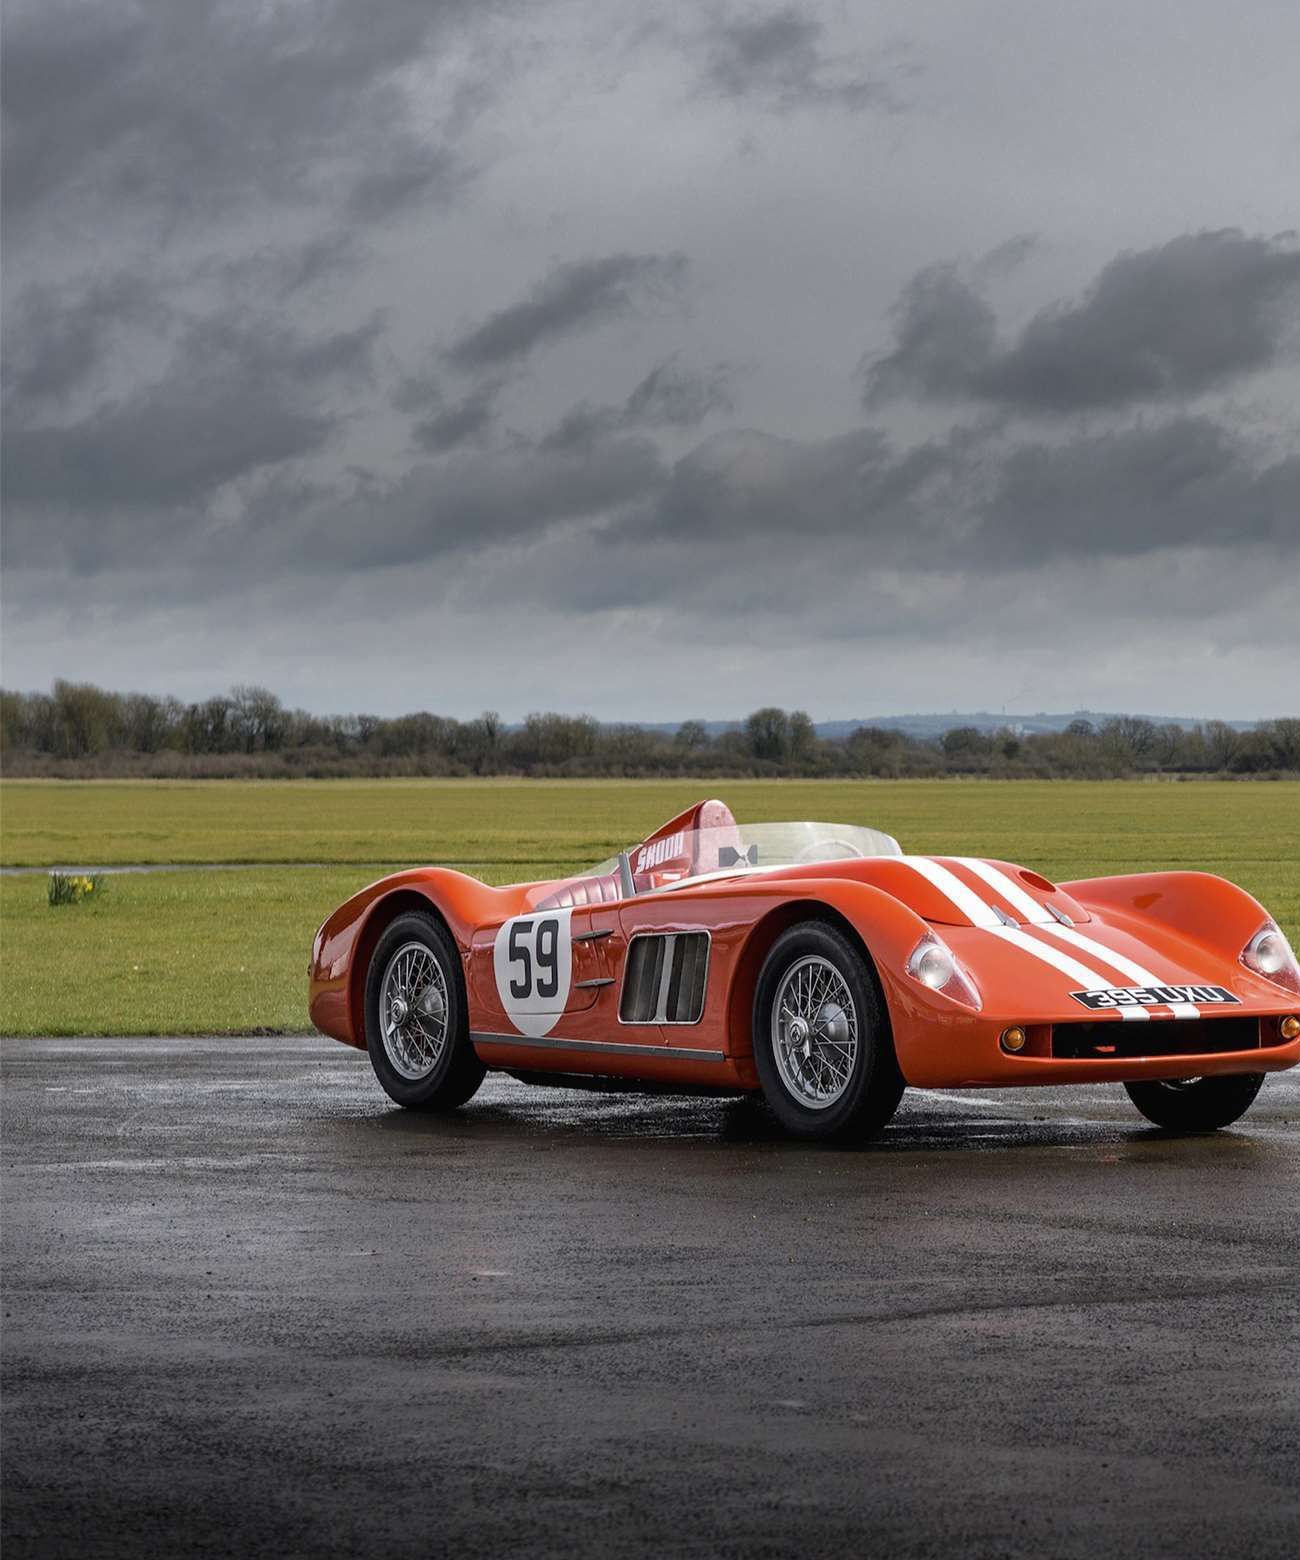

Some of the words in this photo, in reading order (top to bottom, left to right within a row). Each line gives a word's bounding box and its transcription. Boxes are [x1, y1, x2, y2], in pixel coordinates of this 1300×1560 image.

[510, 921, 559, 998] 59
[1087, 991, 1158, 1007] 395
[1153, 987, 1226, 1002] UXU
